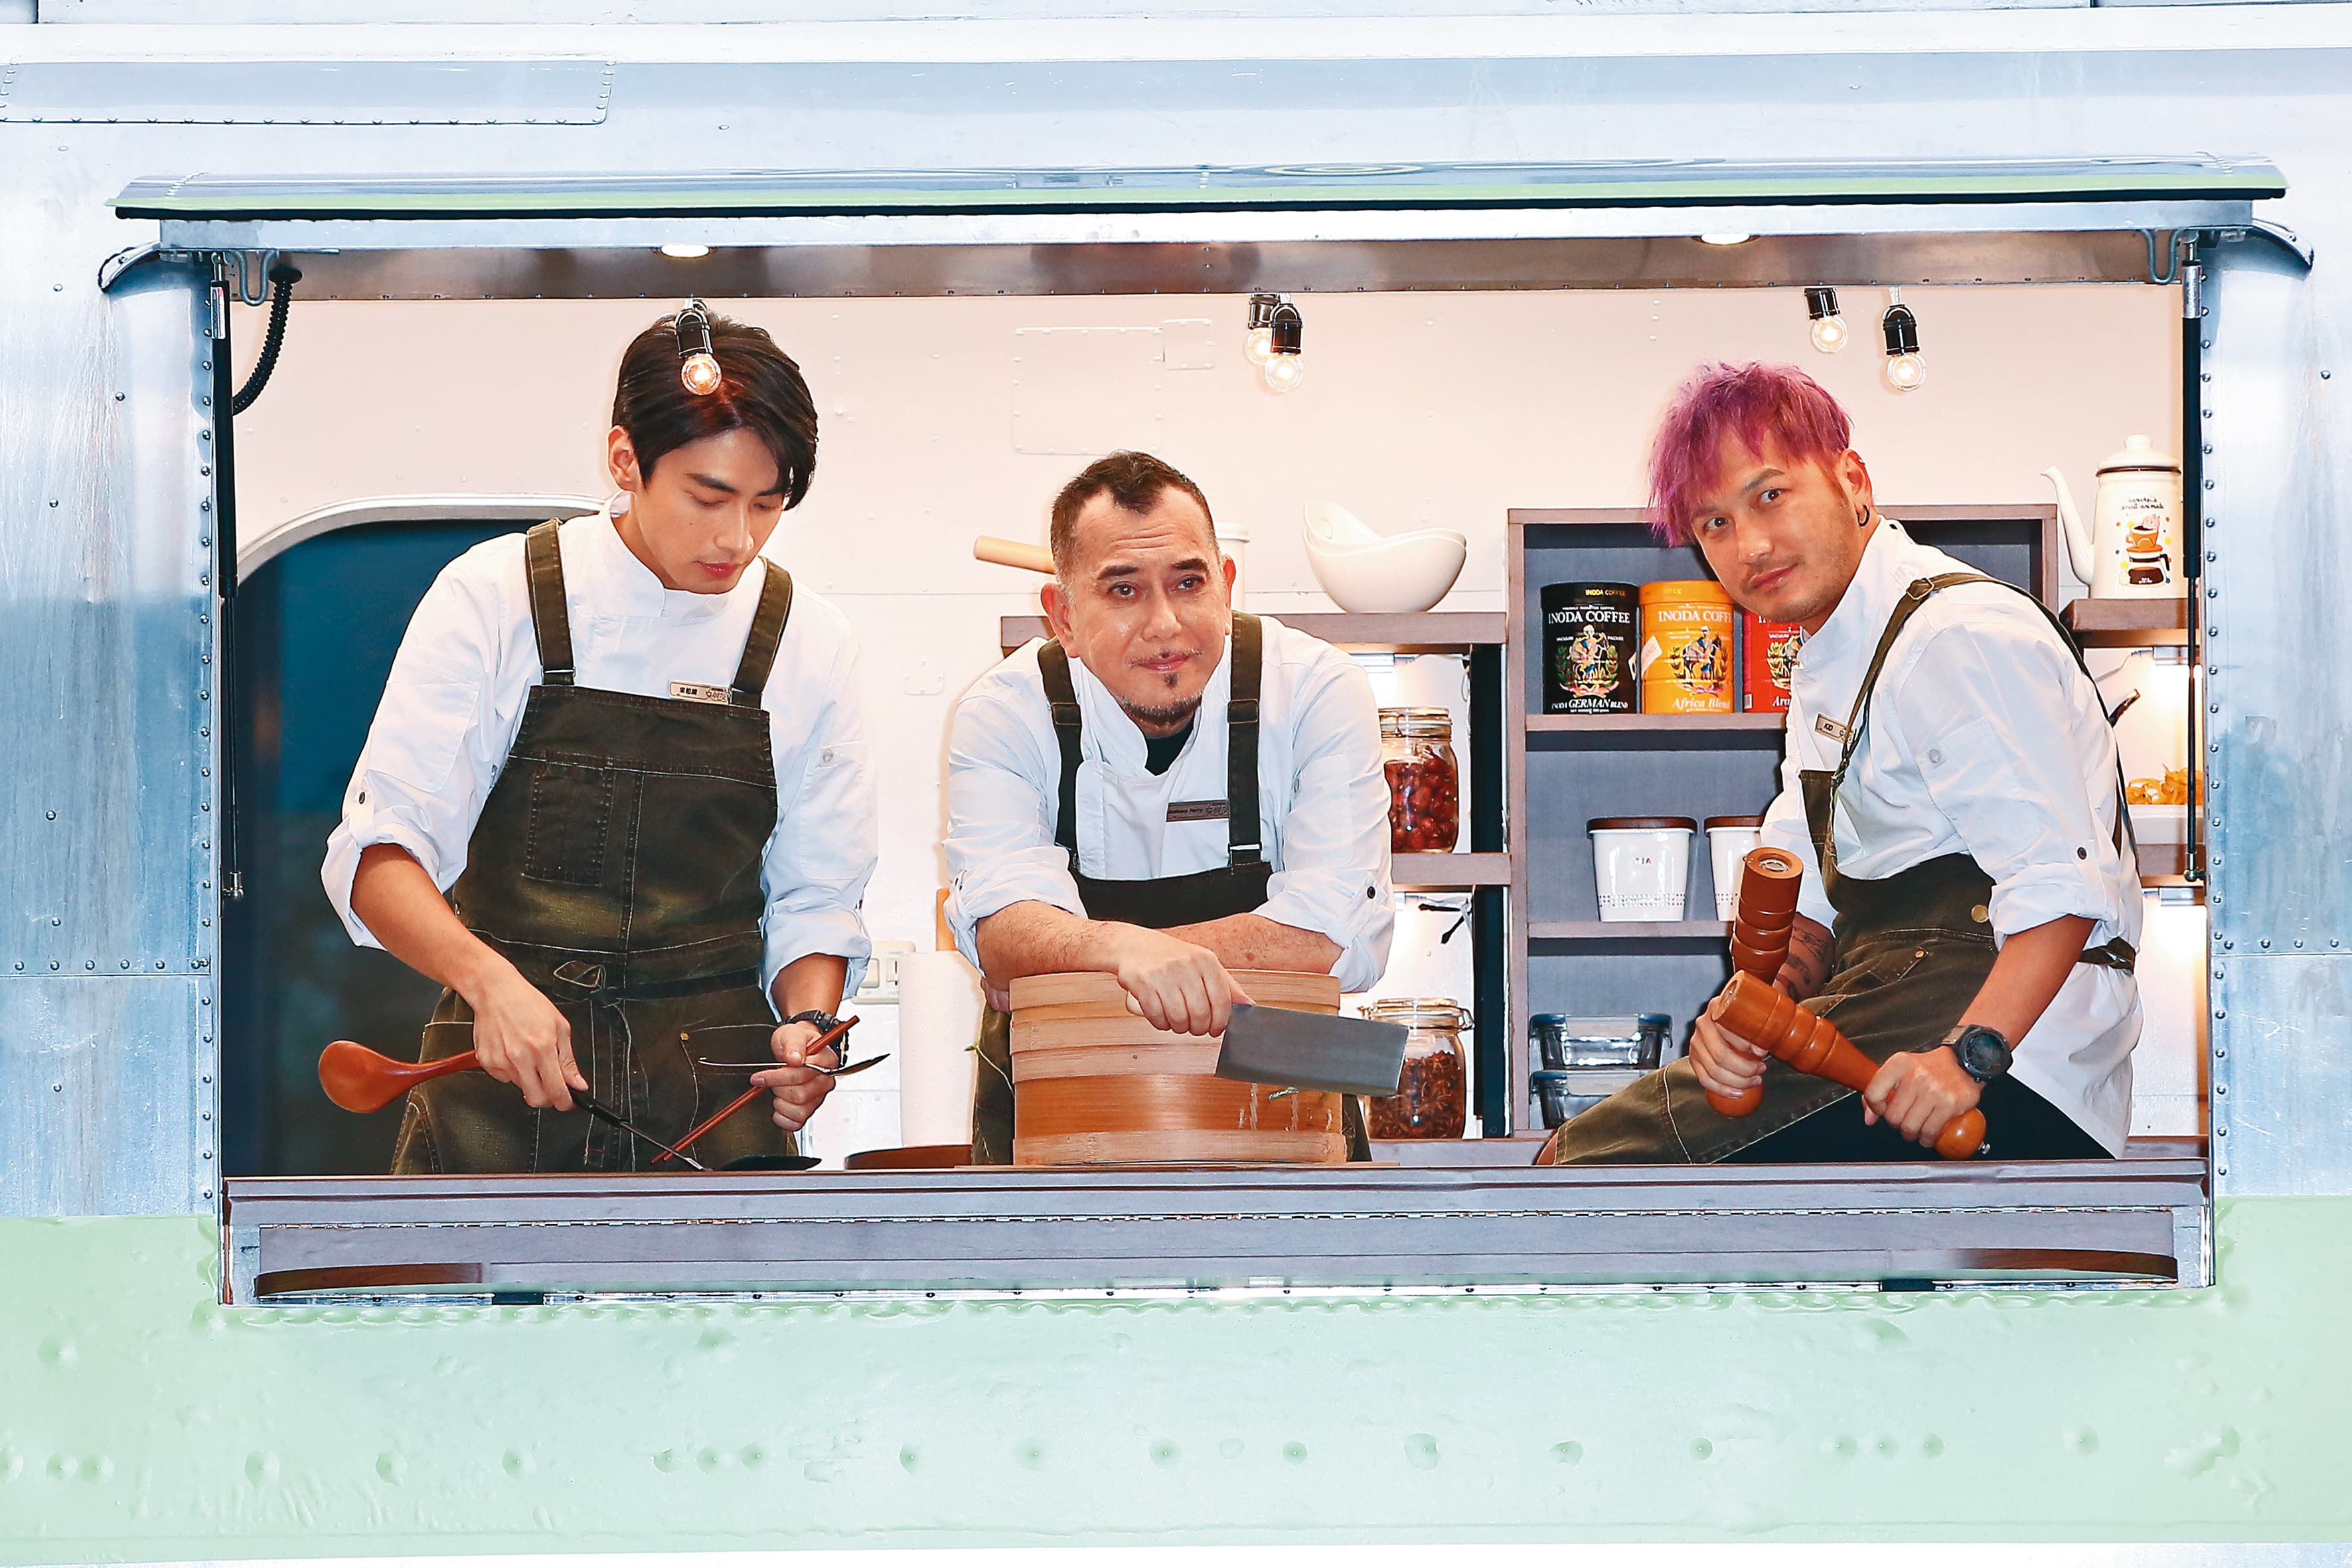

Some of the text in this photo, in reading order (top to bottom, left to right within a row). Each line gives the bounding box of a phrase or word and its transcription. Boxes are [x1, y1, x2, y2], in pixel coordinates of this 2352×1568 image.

[1548, 611, 1630, 624] INODA COFFEE
[1658, 610, 1700, 622] INODA
[1569, 698, 1610, 709] GERMAN
[1673, 698, 1705, 711] Africa
